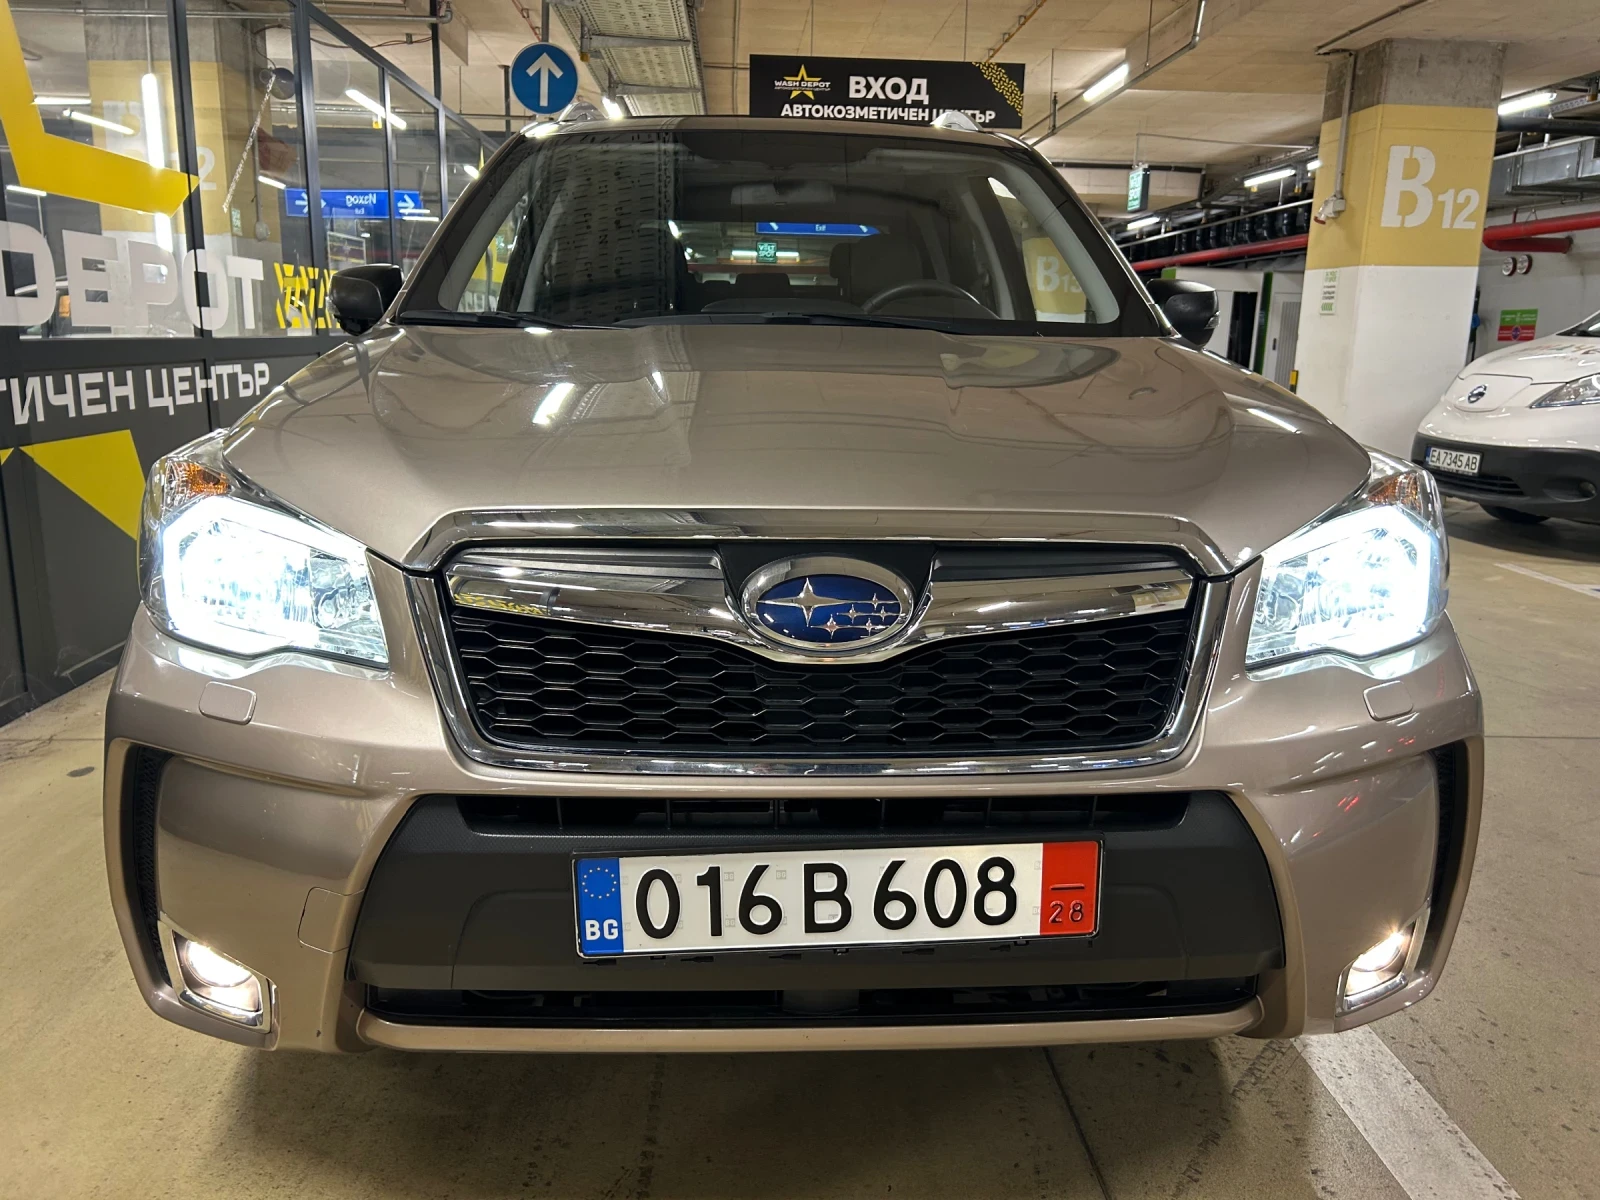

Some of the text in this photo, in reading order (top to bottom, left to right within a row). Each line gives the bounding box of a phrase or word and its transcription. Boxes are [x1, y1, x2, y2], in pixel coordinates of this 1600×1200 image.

[848, 75, 930, 105] ВХОД
[780, 103, 929, 121] АВТОКОЗМЕТИЧЕН
[0, 220, 265, 331] DEPOT
[145, 362, 270, 416] ЦЕНТЪР
[1049, 899, 1085, 924] 28
[584, 918, 619, 941] BG
